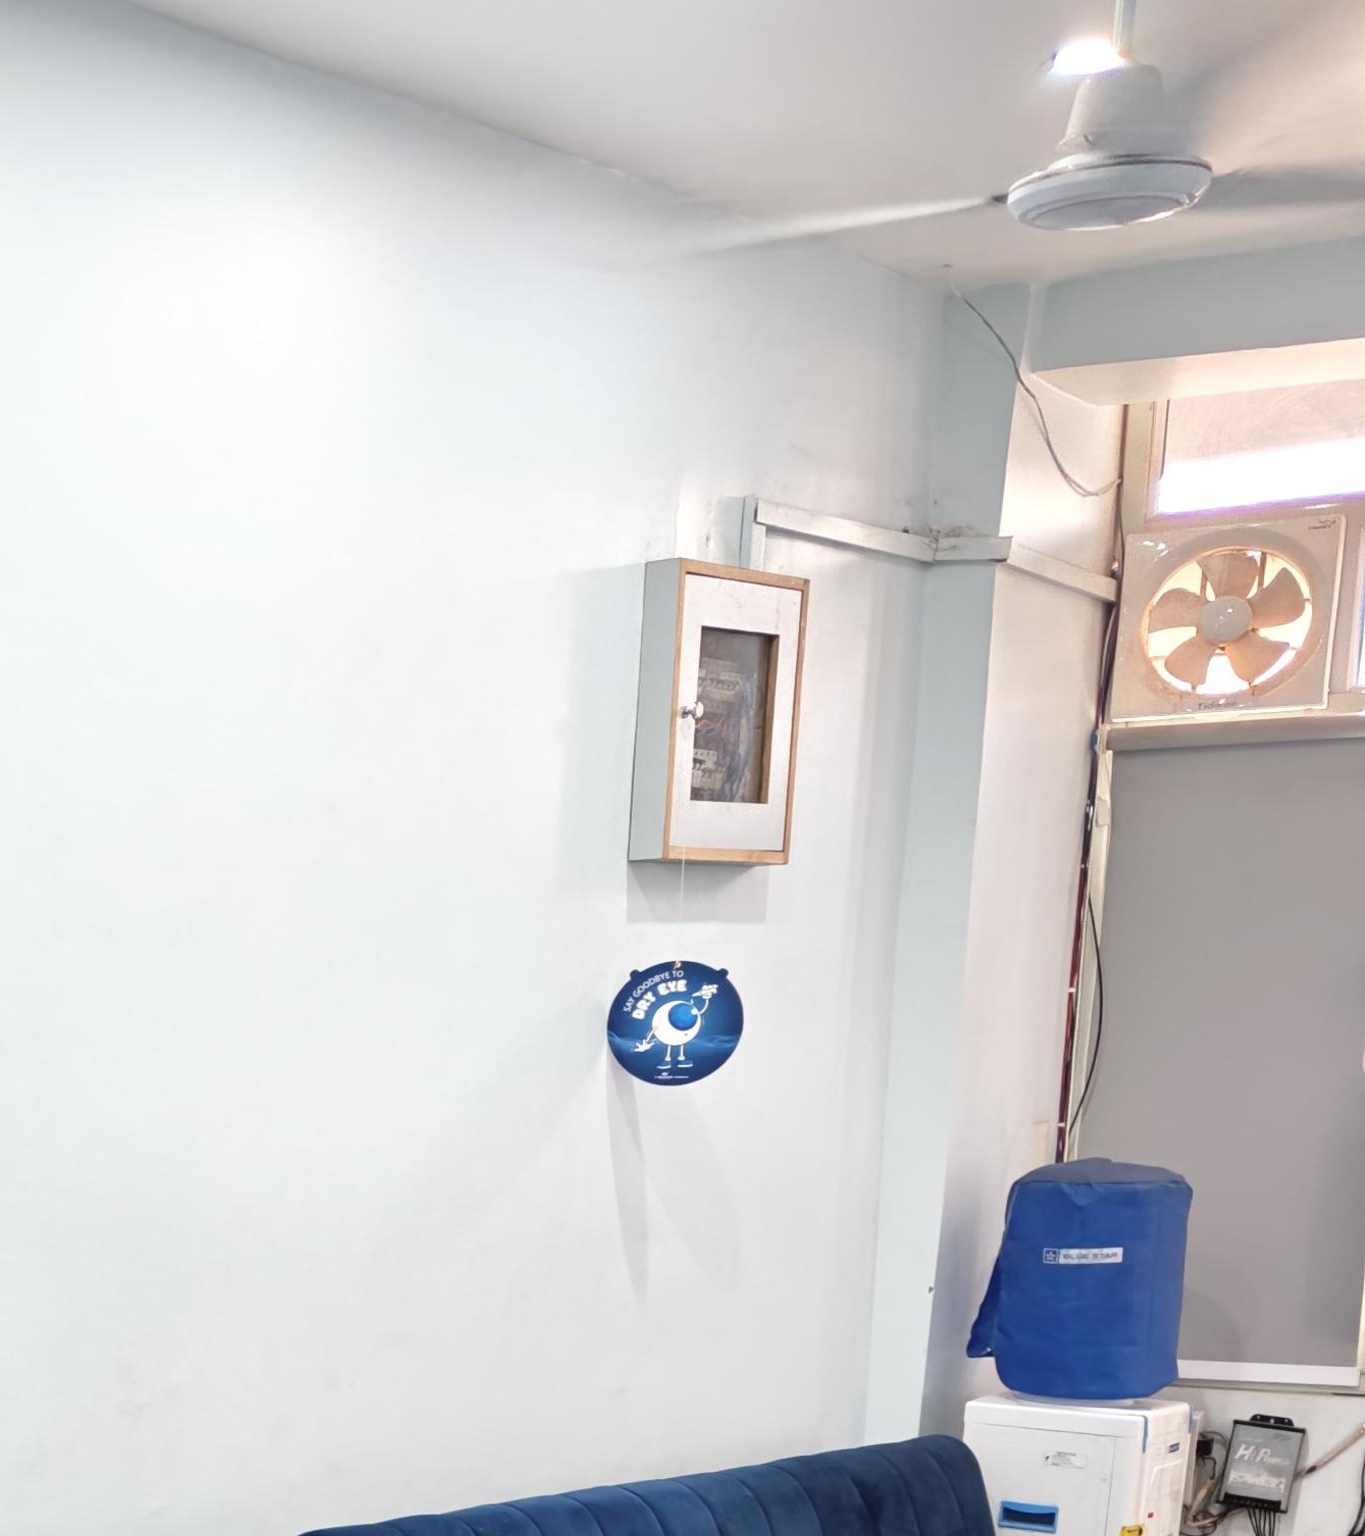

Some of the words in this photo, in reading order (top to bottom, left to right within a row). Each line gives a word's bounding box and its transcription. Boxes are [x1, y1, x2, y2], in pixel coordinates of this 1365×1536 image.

[623, 997, 636, 1013] SAY
[632, 971, 671, 998] GOODBYE
[672, 969, 685, 978] TO
[631, 991, 657, 1020] DRY
[657, 979, 688, 996] EYE
